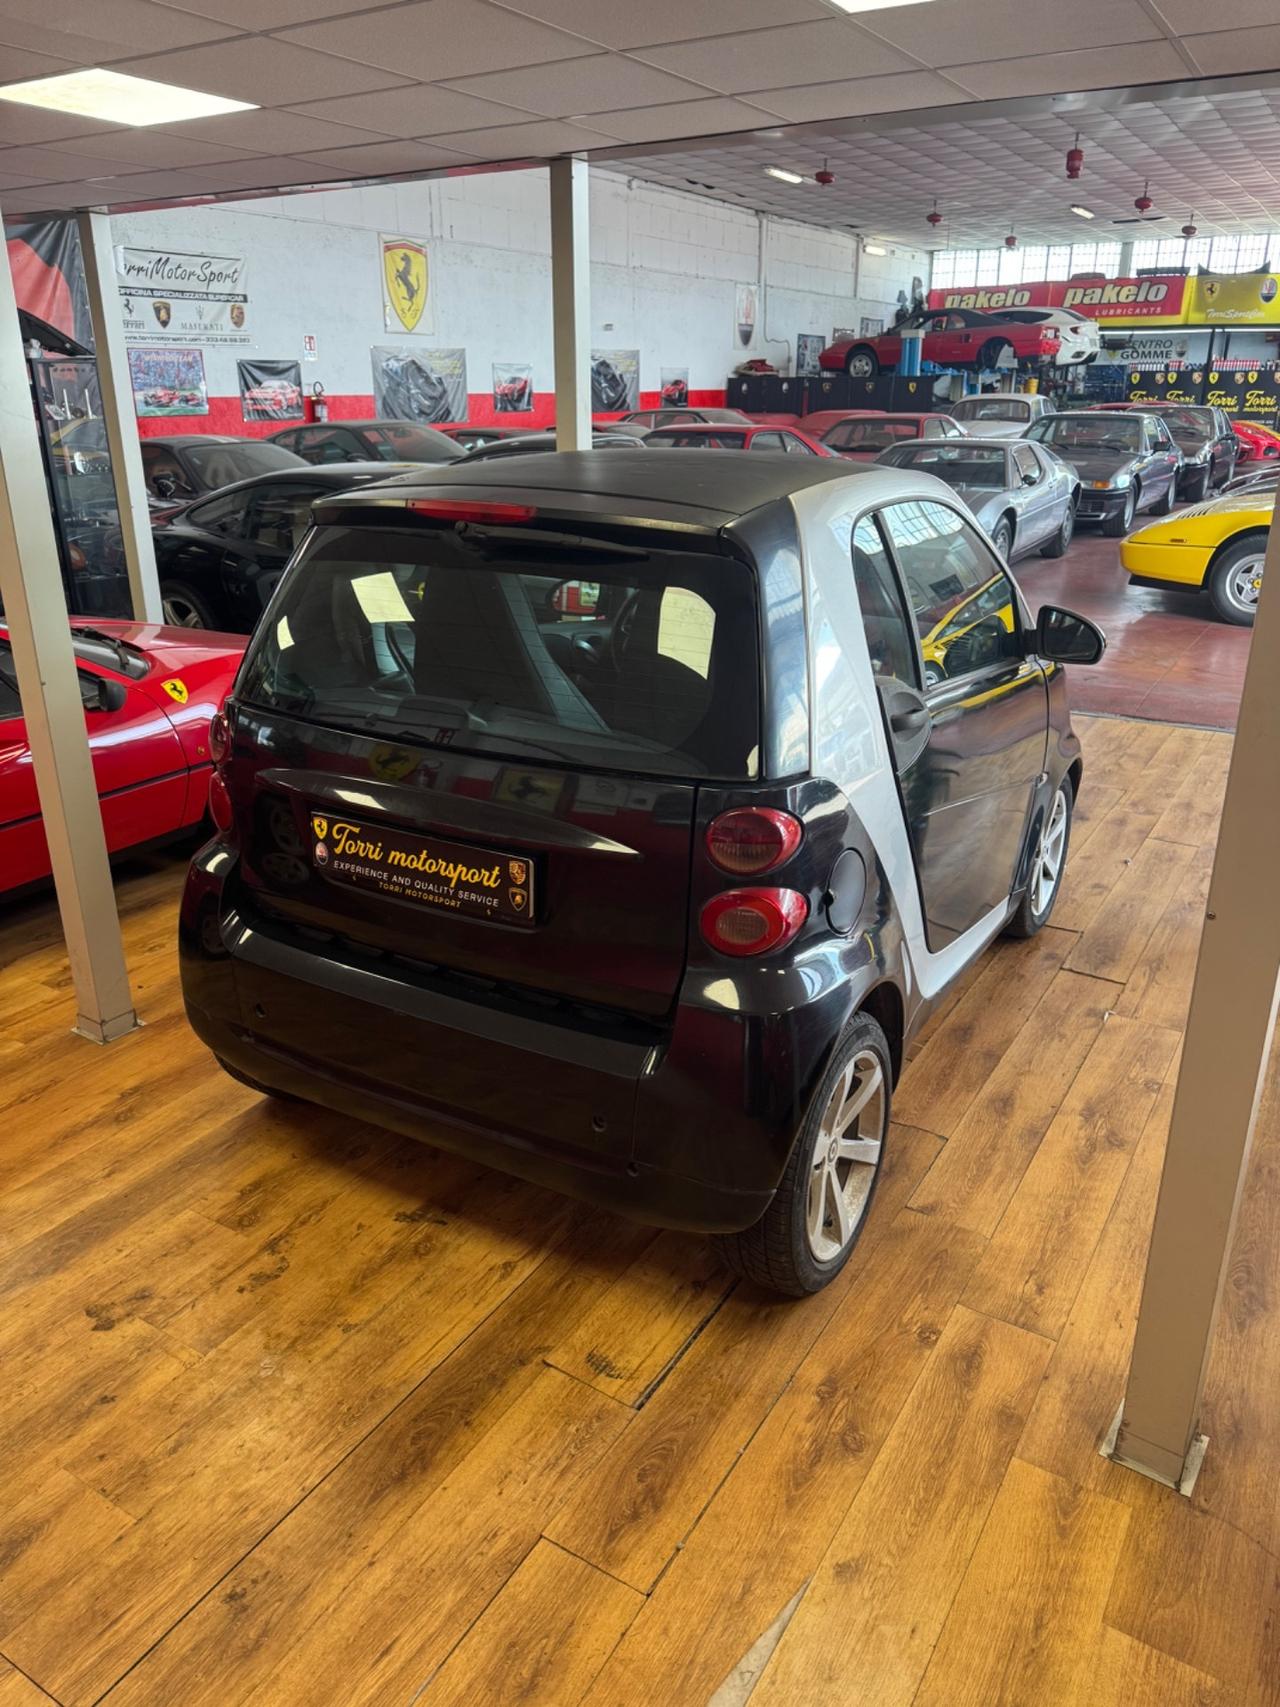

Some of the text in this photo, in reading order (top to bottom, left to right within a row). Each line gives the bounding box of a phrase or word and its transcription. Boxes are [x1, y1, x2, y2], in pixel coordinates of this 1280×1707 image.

[944, 288, 1031, 309] pakelo
[1062, 281, 1169, 308] pakelo
[1094, 306, 1162, 316] LUBRICANTS
[1131, 339, 1173, 349] ENTRO
[1120, 350, 1172, 359] GOMME
[1206, 390, 1238, 406] Torri
[1244, 390, 1277, 406] Torri
[332, 823, 501, 888] Torri motorsport
[333, 860, 500, 908] EXPERIENCE AND QUALITY SERVICE
[379, 881, 462, 908] TORRI MOTORSPORT
